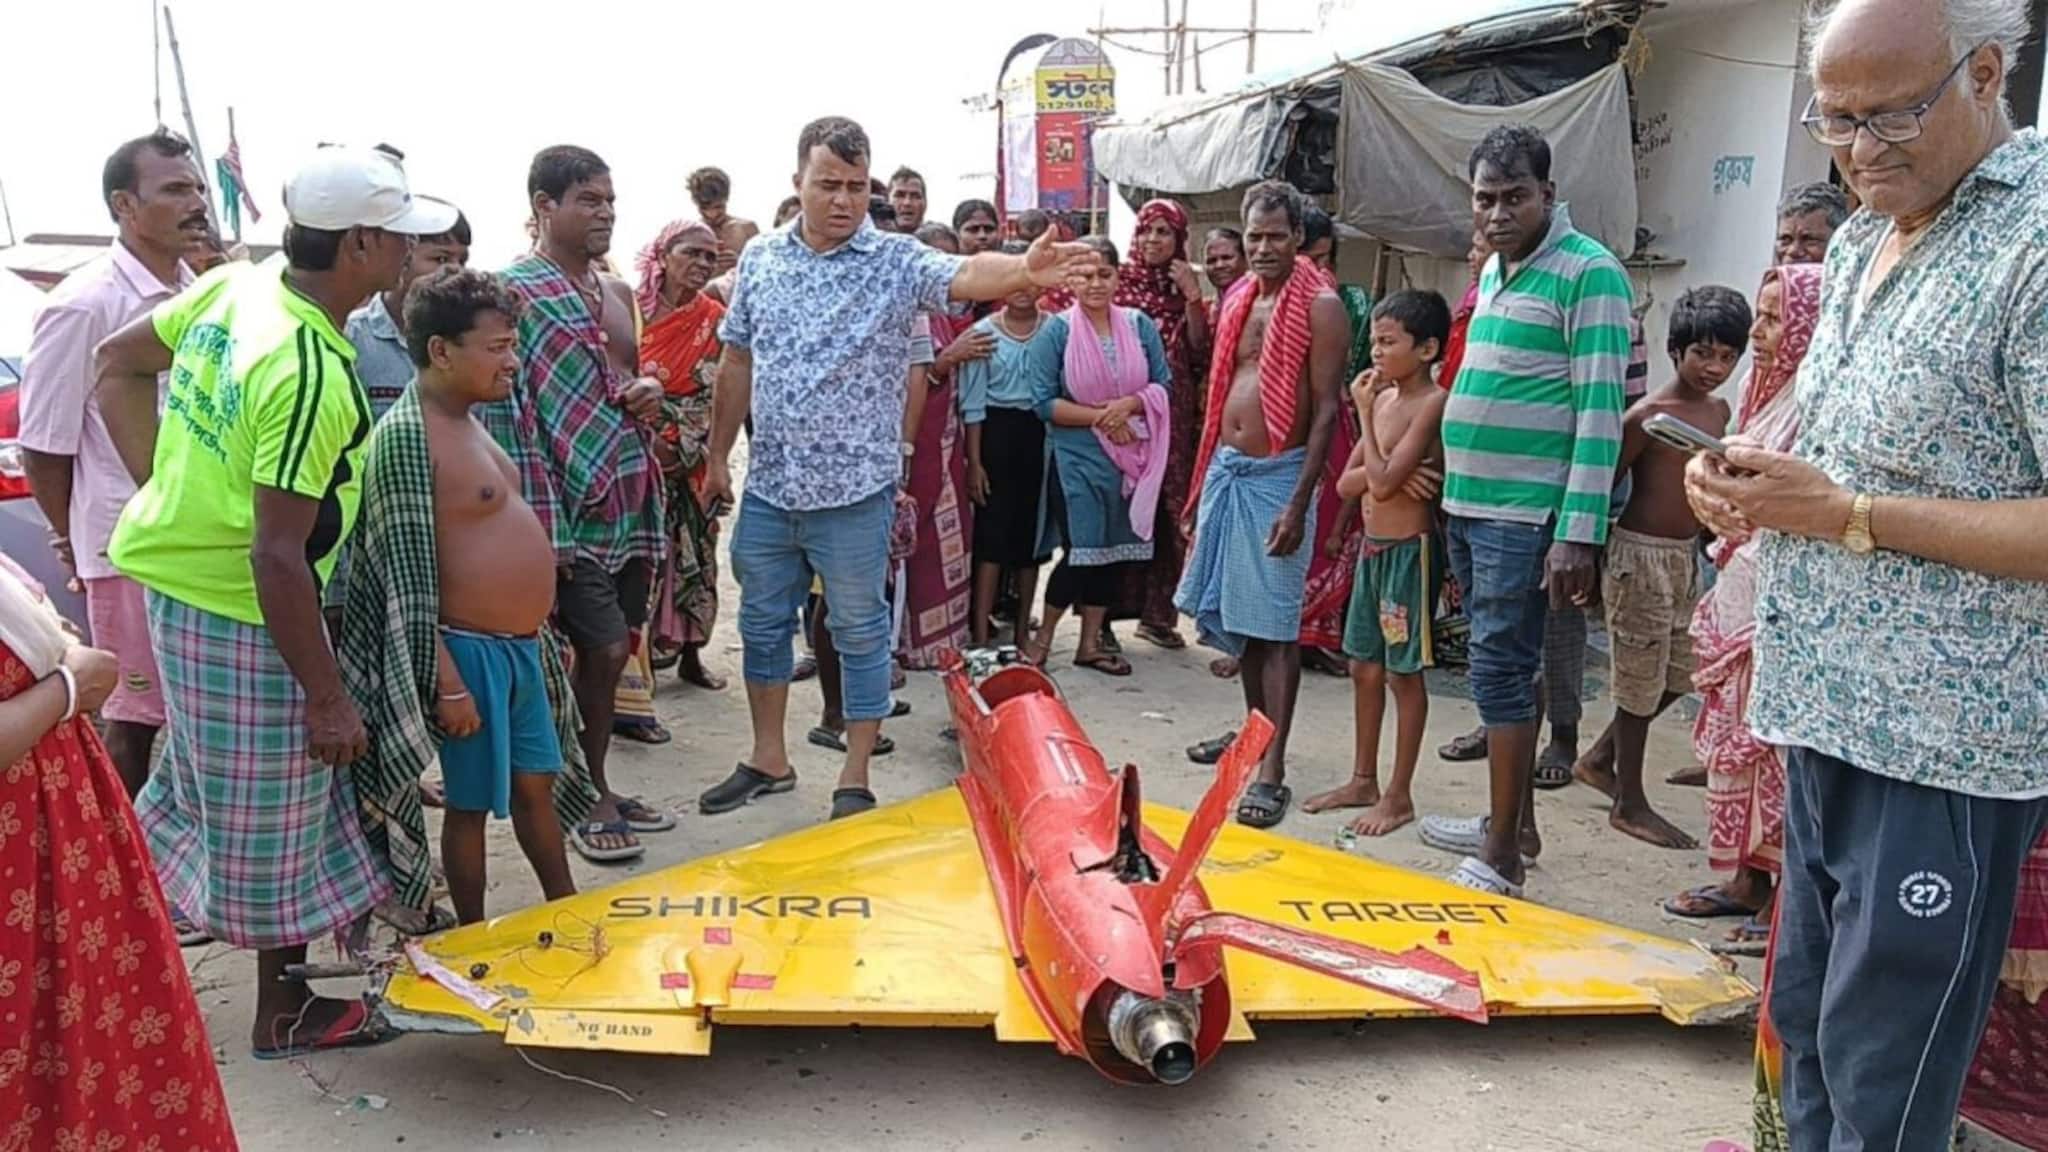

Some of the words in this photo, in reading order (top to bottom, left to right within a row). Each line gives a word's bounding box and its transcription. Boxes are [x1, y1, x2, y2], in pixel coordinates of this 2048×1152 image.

[1910, 884, 1939, 905] 27
[608, 896, 871, 918] SHIKRA
[1279, 900, 1510, 924] TARGET
[576, 1022, 600, 1034] NO
[605, 1023, 653, 1036] HAND
